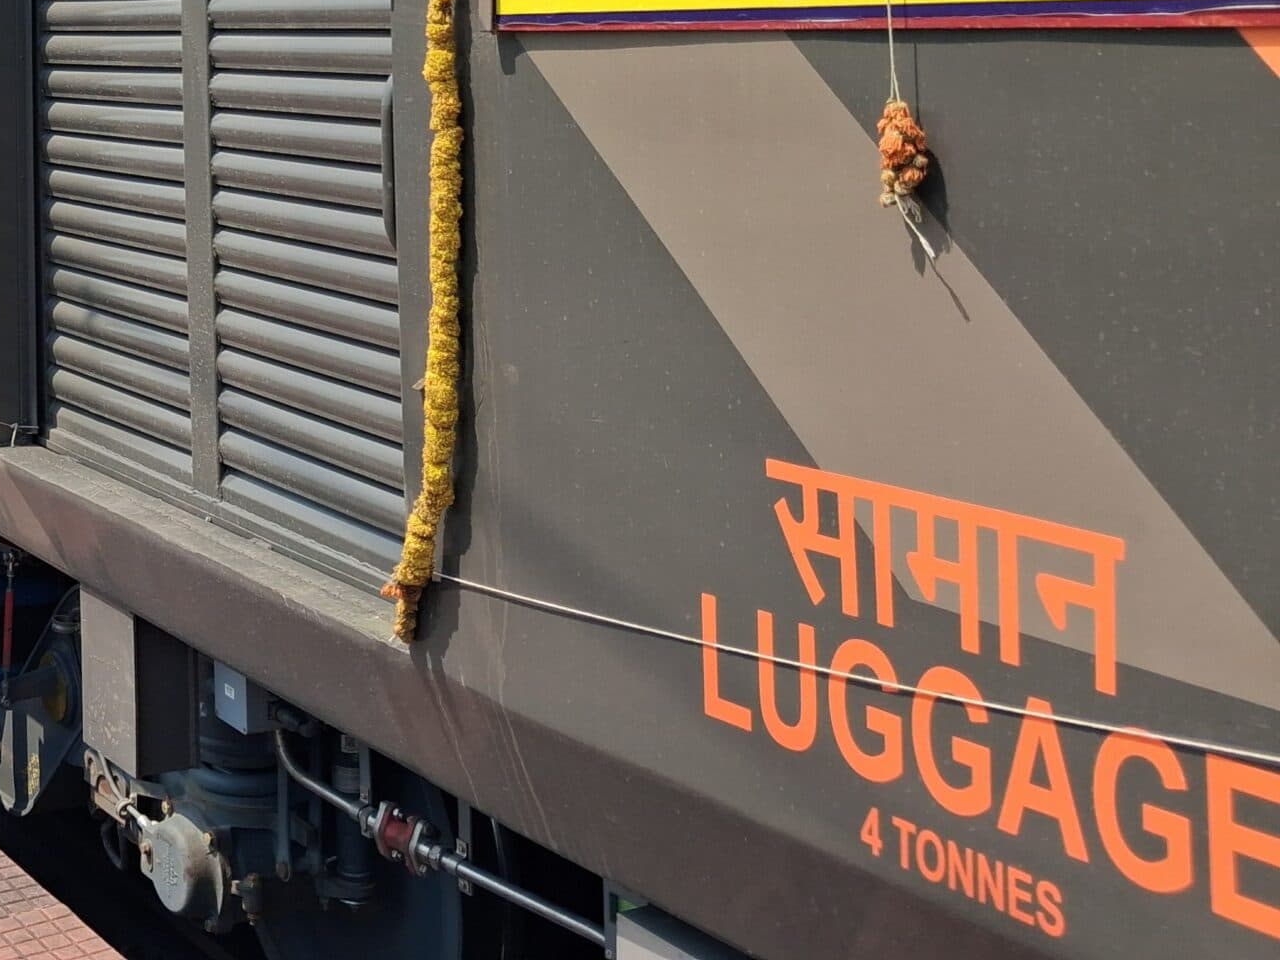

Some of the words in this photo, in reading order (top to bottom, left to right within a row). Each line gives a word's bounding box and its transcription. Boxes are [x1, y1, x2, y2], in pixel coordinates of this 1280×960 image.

[765, 458, 1126, 696] सामान
[701, 592, 1280, 939] LUGGAGE
[860, 807, 882, 856] 4
[891, 816, 1065, 937] TONNES
